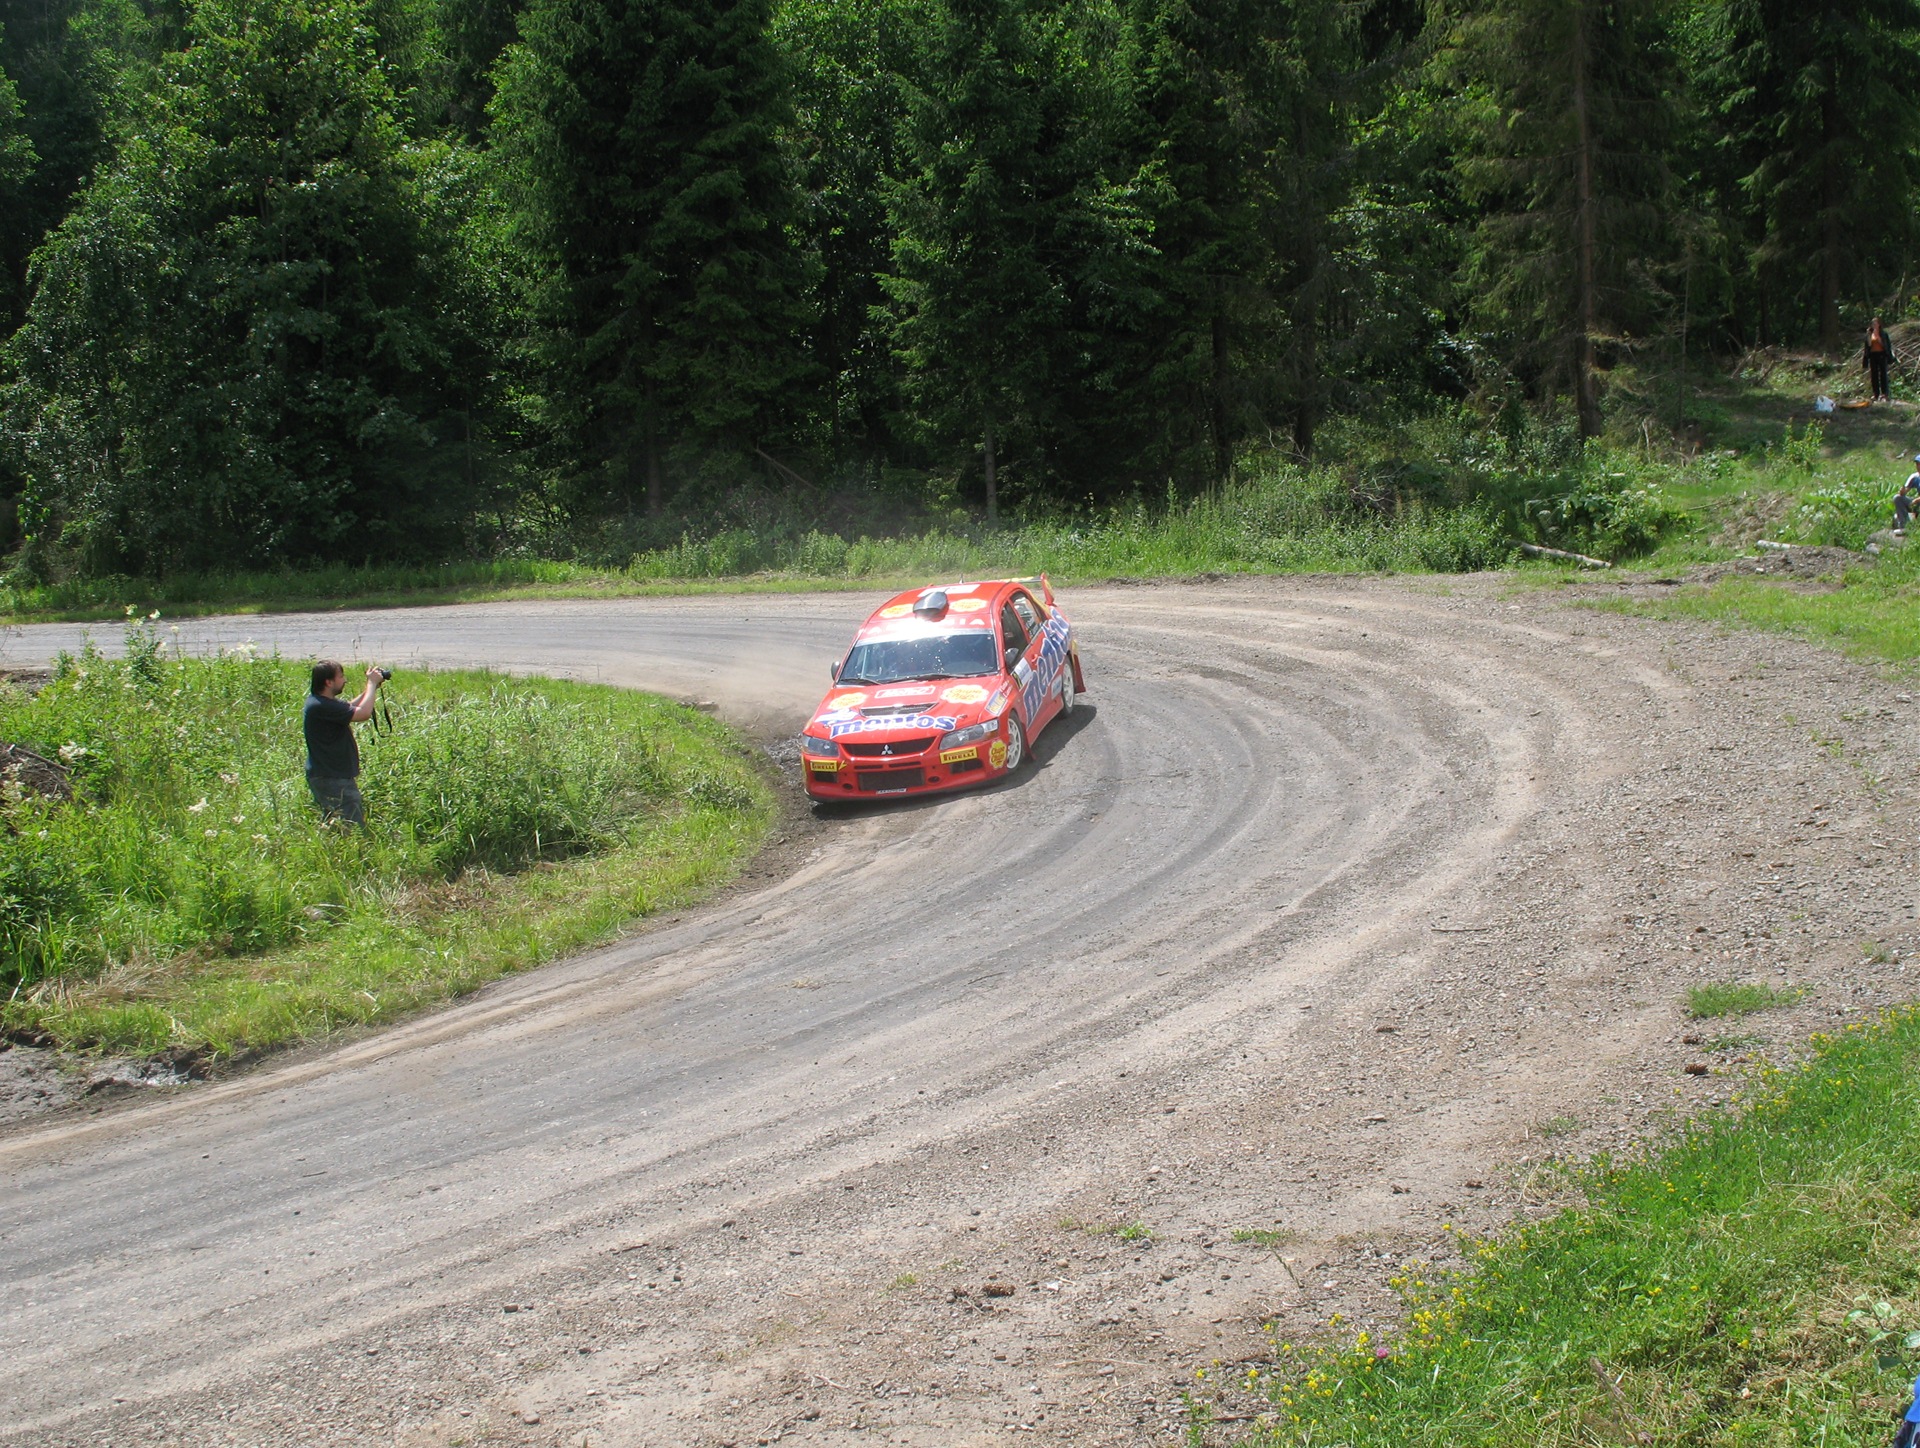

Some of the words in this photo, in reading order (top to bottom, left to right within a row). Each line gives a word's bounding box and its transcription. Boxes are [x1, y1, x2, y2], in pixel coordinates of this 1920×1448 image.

[829, 713, 957, 737] mentos
[943, 749, 975, 761] PIRELLI
[811, 762, 835, 770] PIRELLI
